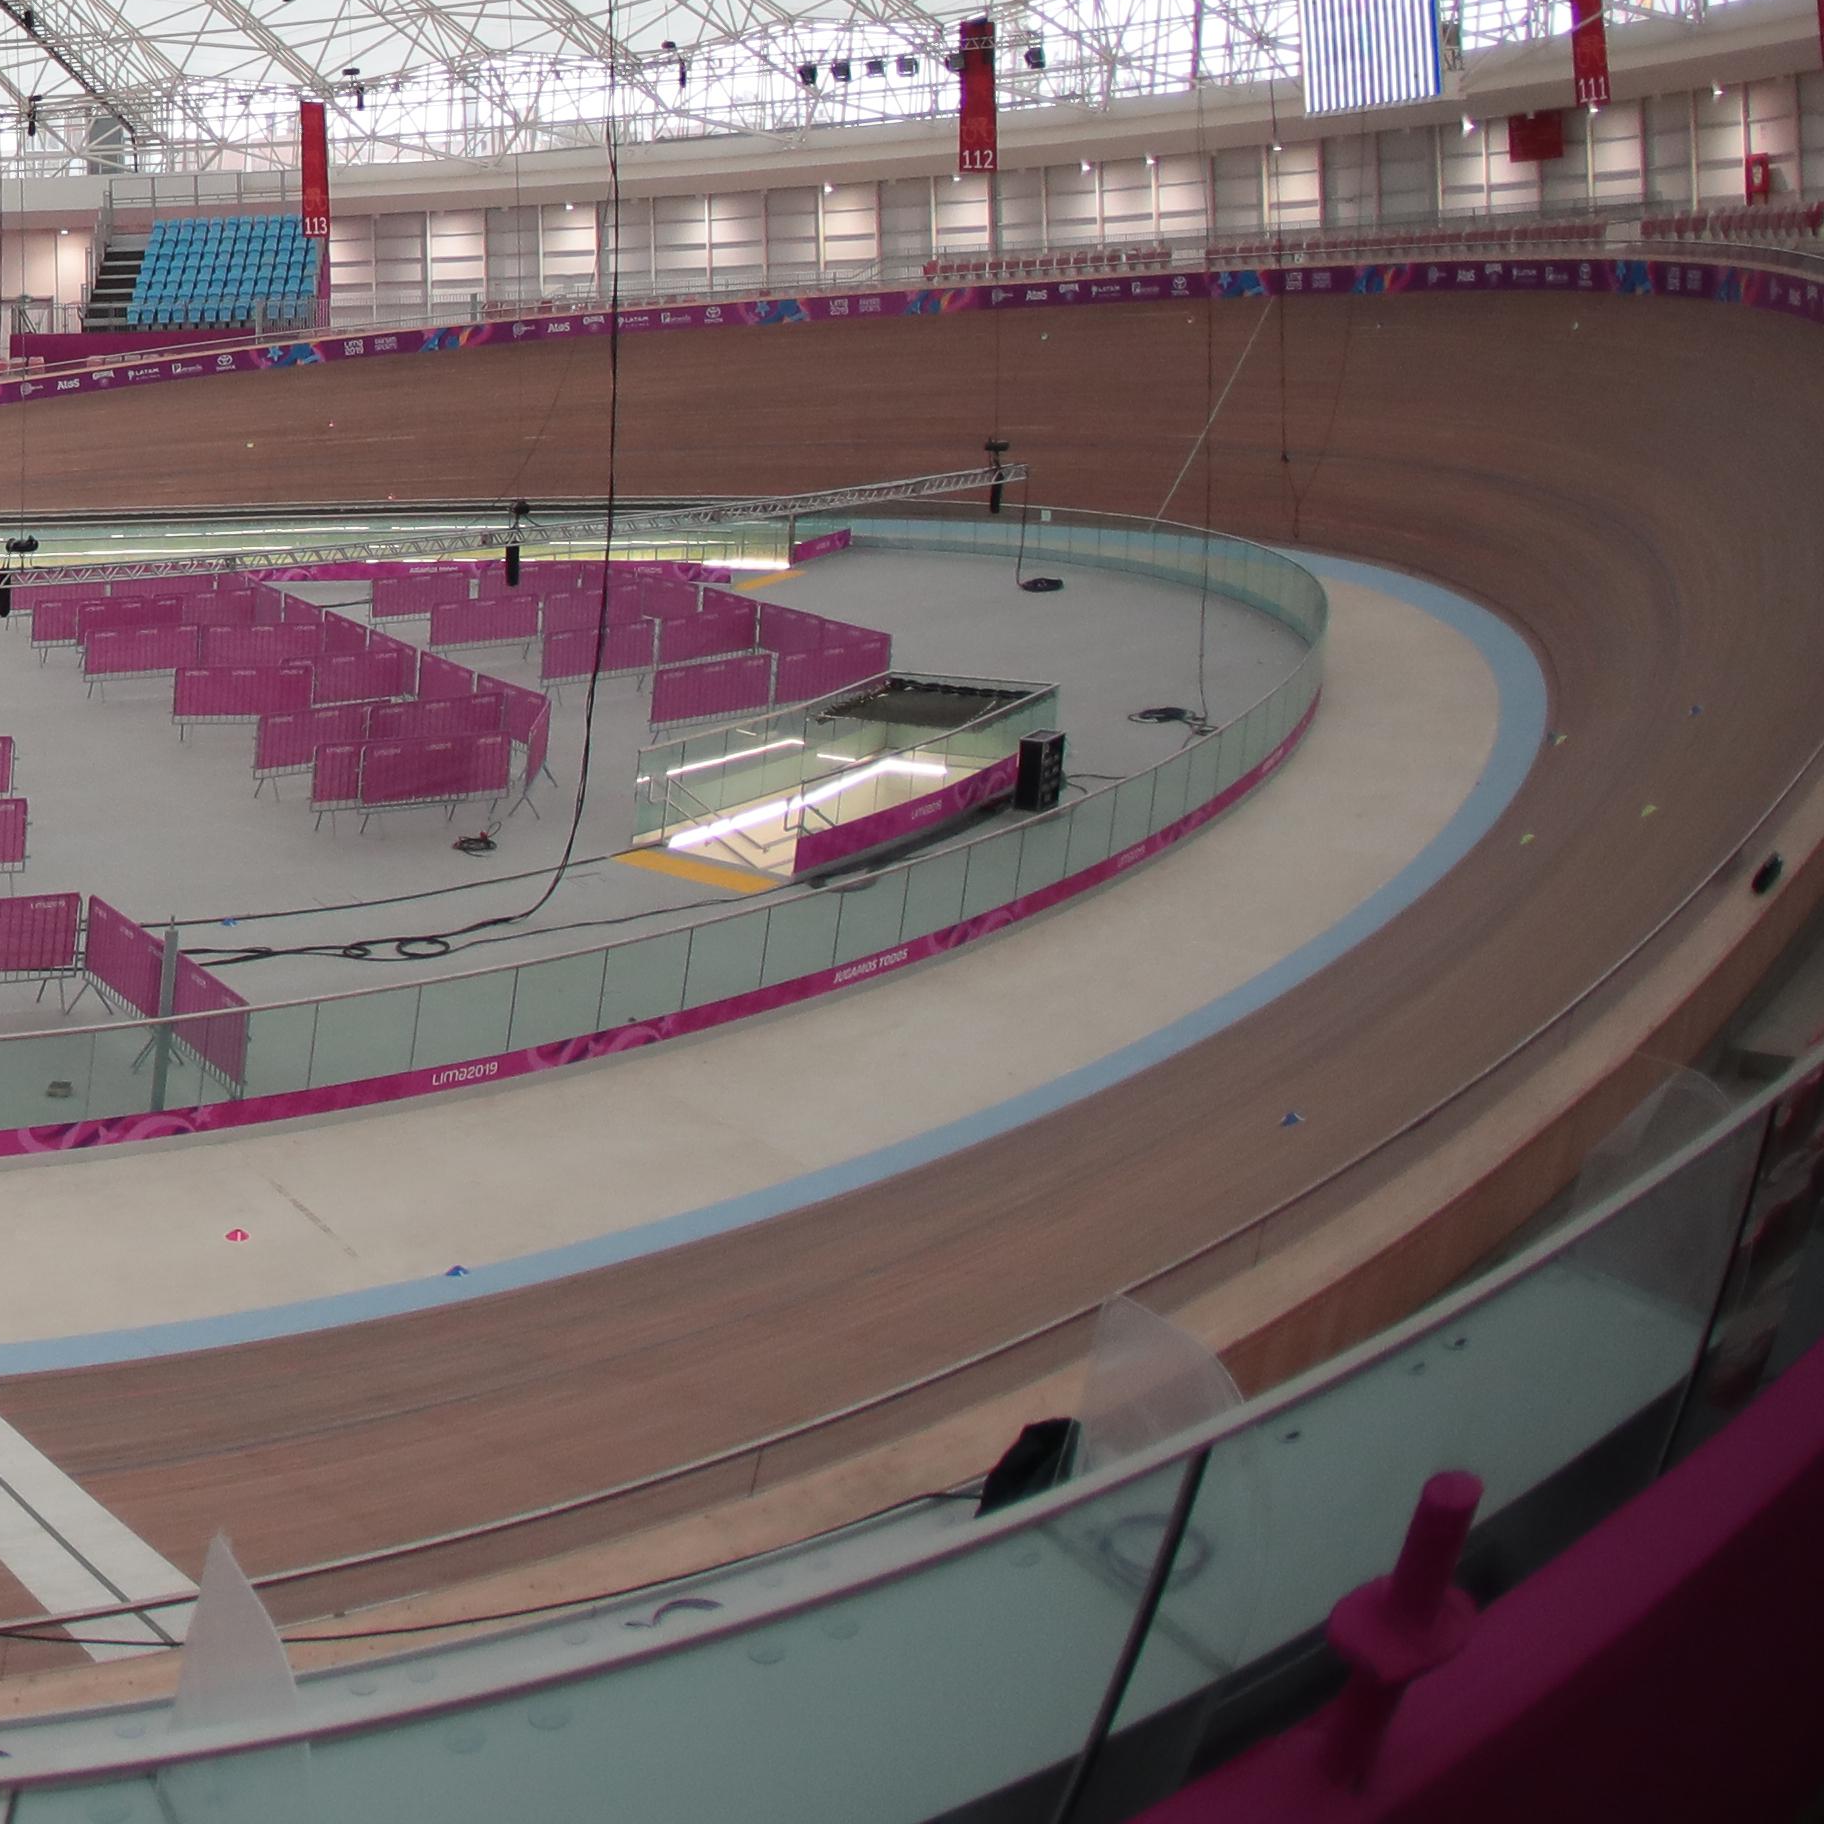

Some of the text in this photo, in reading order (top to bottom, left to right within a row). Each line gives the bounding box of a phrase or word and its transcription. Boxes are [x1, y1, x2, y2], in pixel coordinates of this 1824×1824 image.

[1578, 76, 1608, 102] 111
[962, 150, 994, 169] 112
[304, 217, 328, 234] 113
